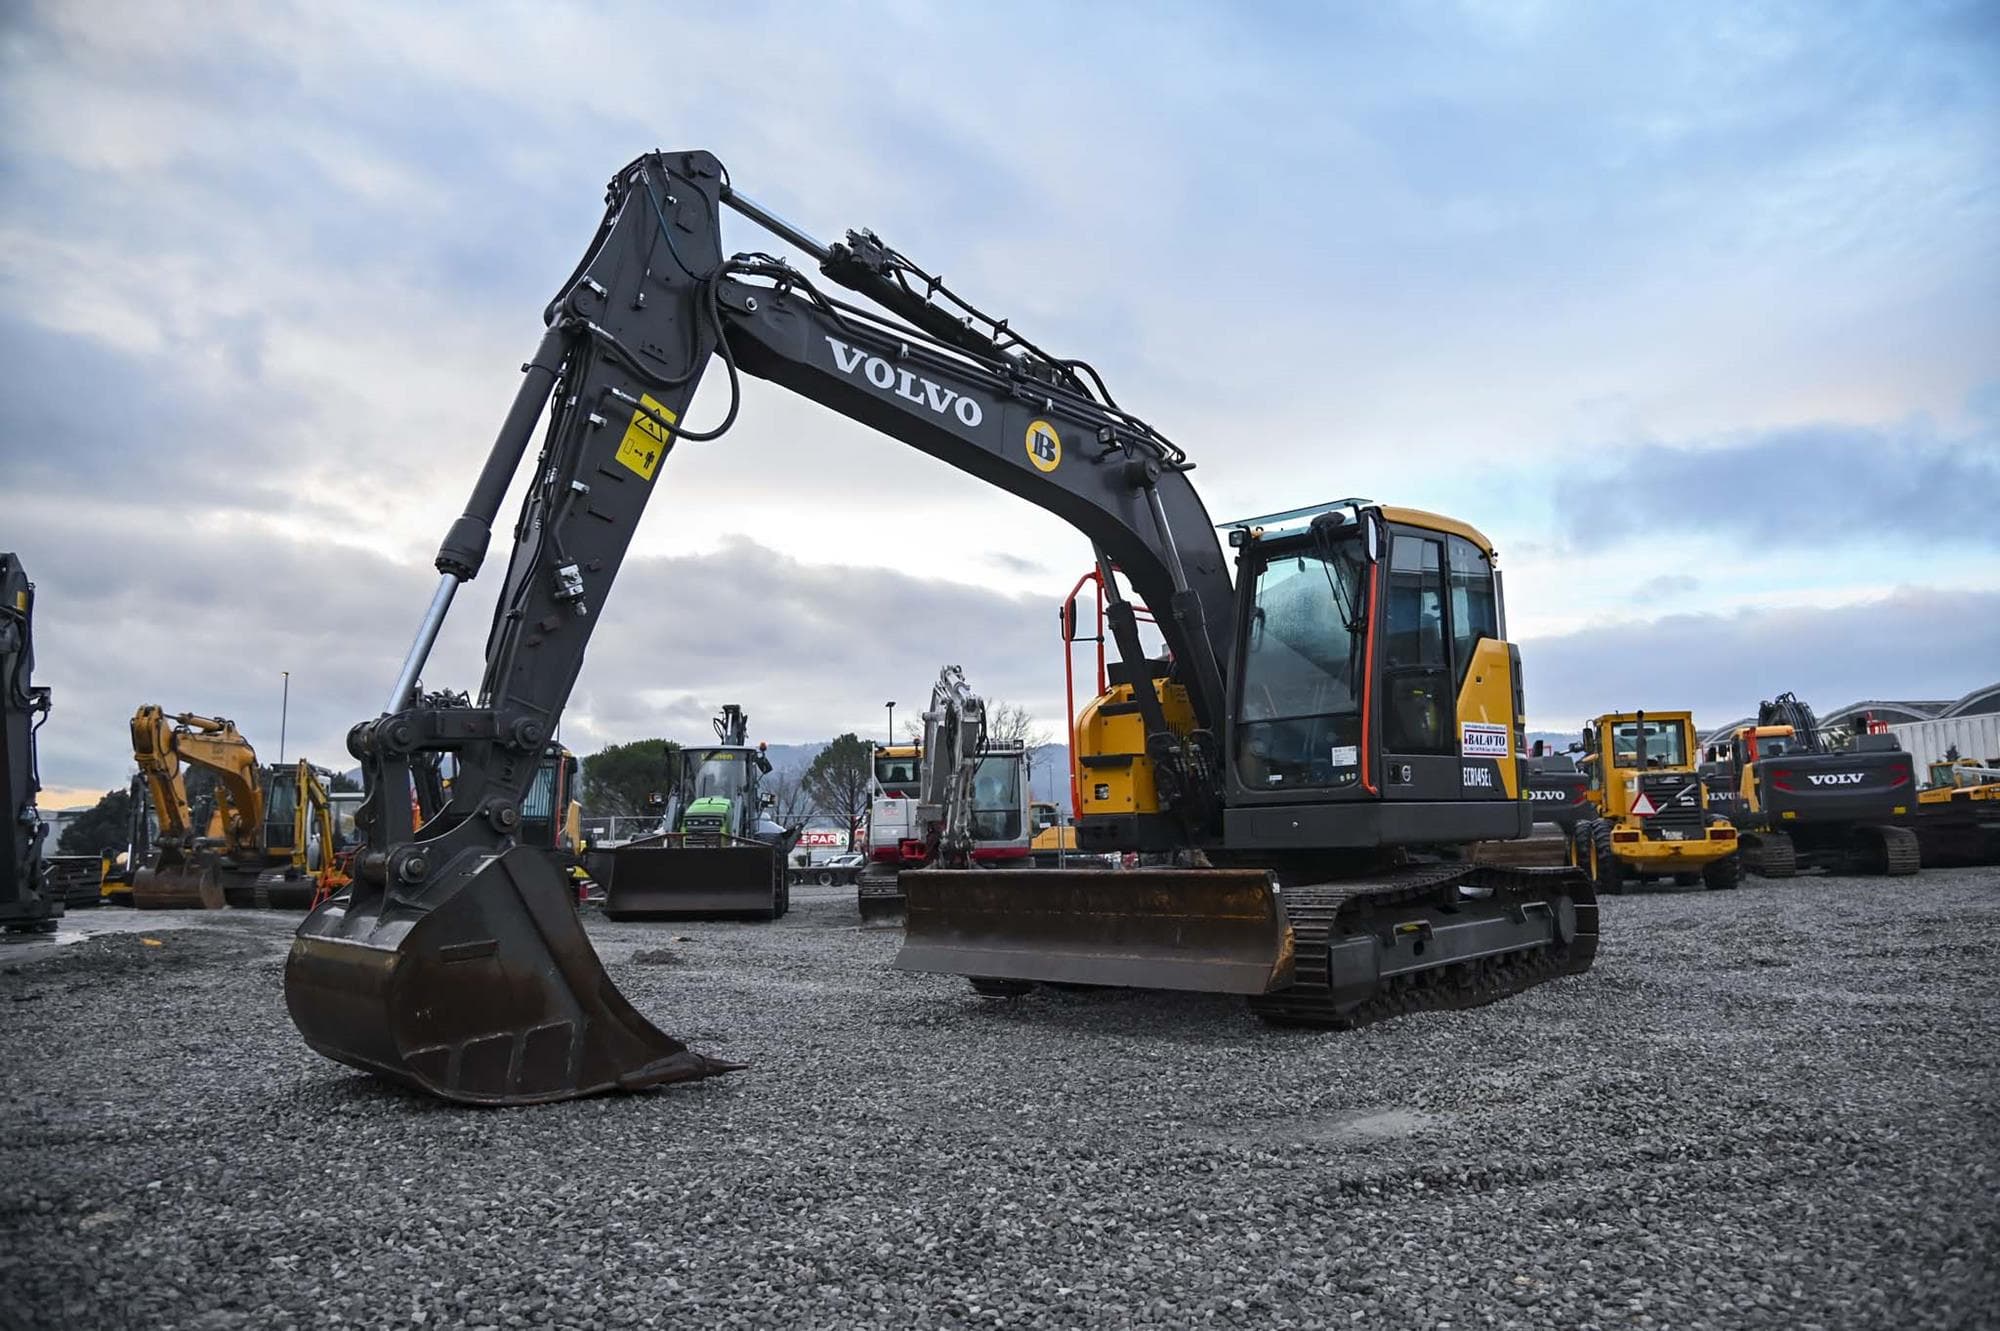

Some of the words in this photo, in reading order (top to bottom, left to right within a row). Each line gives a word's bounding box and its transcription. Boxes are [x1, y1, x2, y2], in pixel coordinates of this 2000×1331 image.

[825, 336, 983, 427] VOLVO
[1468, 733, 1506, 747] BALAVTO
[1807, 772, 1865, 785] VOLV
[1528, 790, 1566, 800] OLVO
[802, 835, 836, 844] SPAR
